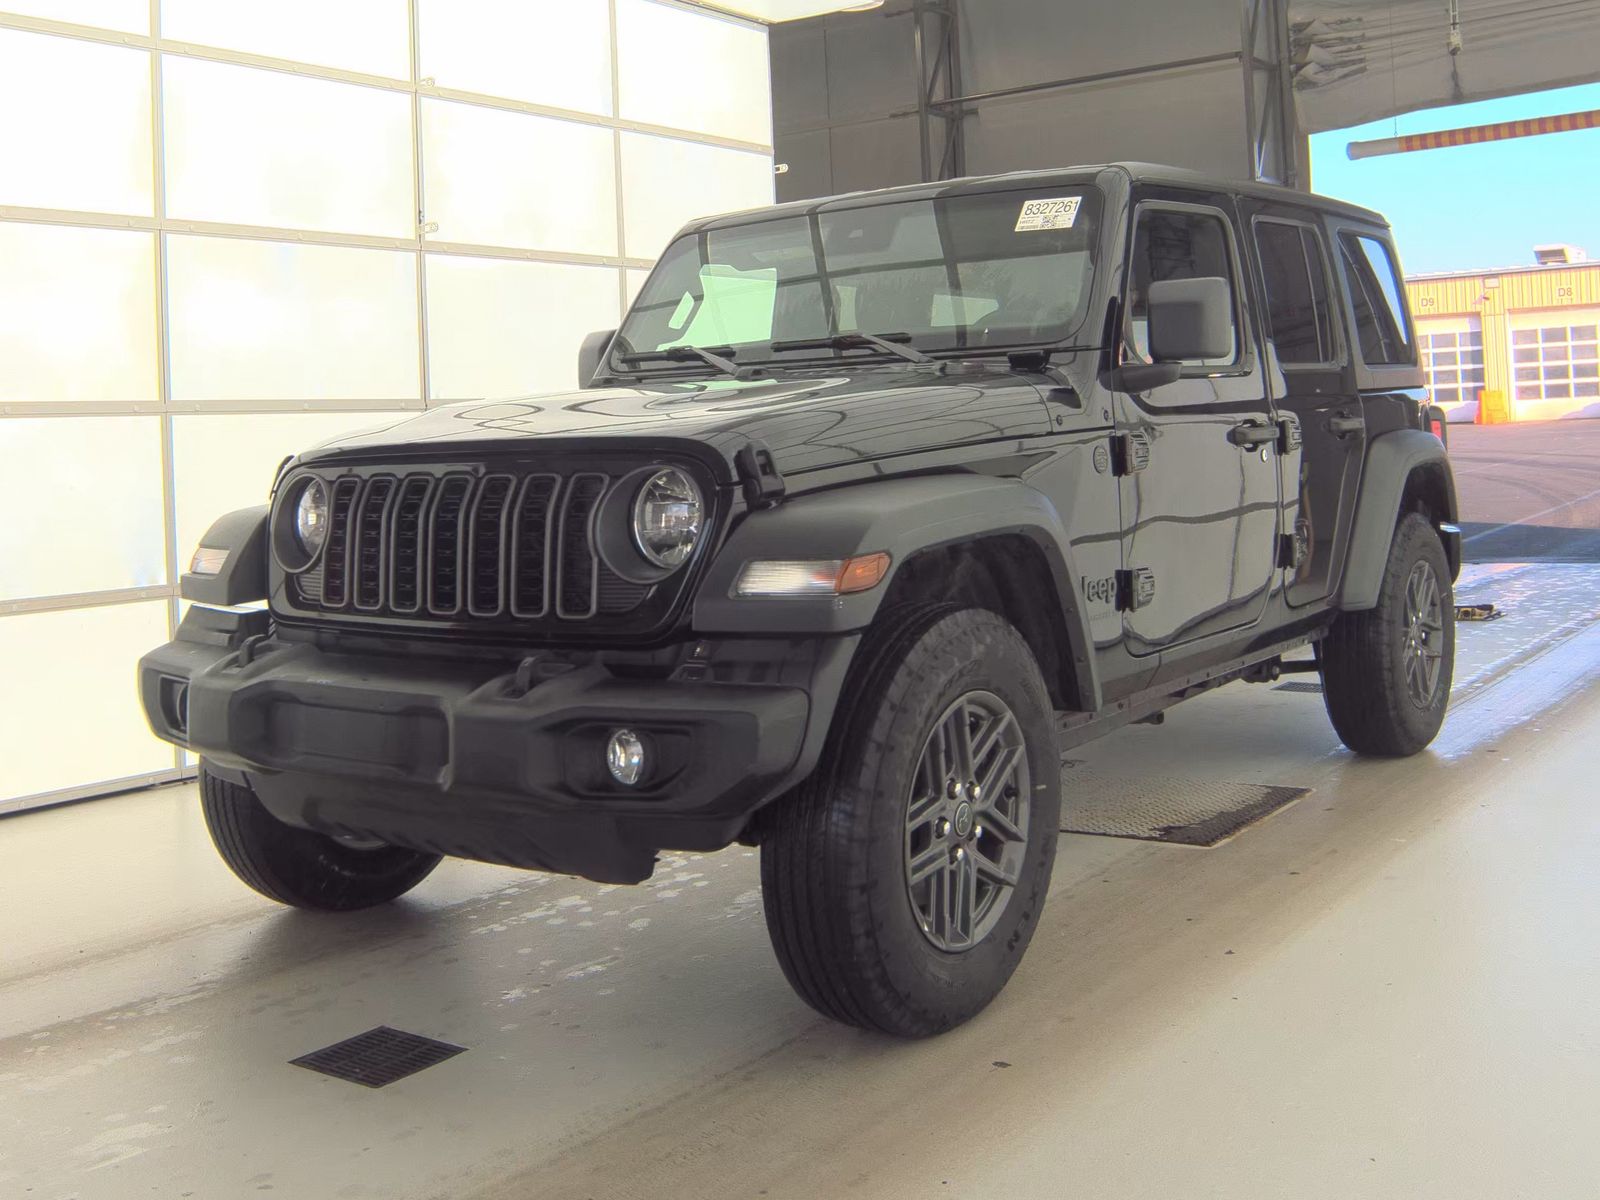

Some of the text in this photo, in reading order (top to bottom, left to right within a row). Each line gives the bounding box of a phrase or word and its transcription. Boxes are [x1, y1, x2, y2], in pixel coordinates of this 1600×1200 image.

[1024, 200, 1079, 216] 8327261
[1558, 287, 1572, 297] D8
[1421, 297, 1434, 307] D9
[1081, 575, 1117, 604] Jeep
